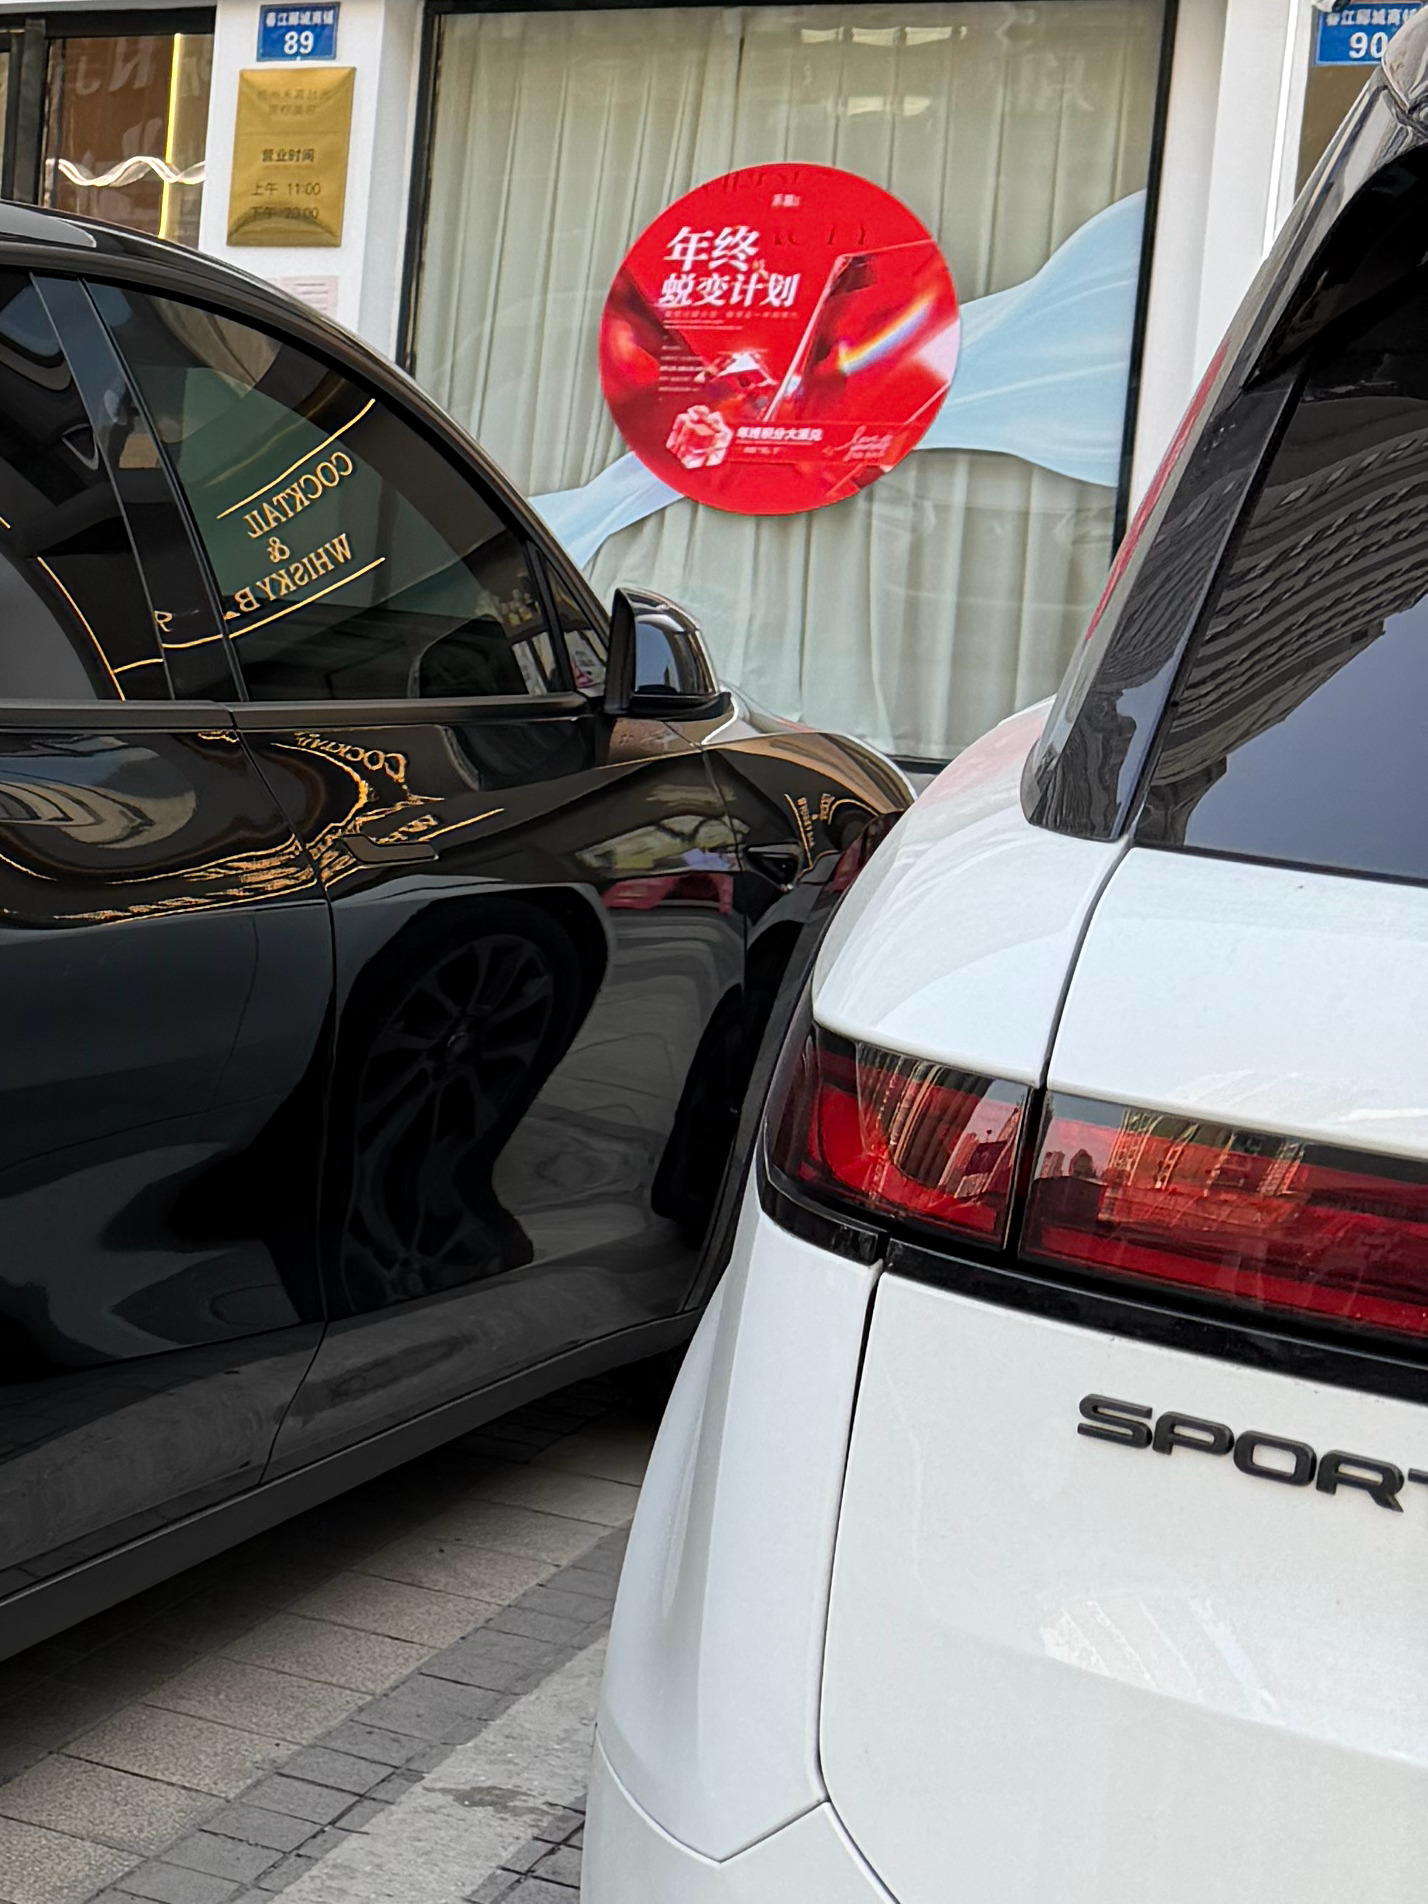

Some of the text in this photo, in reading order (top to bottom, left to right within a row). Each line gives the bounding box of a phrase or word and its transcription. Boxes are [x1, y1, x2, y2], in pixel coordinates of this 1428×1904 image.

[284, 30, 314, 54] 89
[1349, 32, 1388, 59] 90
[262, 147, 315, 163] 营业时间
[250, 181, 278, 196] 上午
[663, 225, 761, 272] 年终
[656, 273, 801, 308] 蜕变计划
